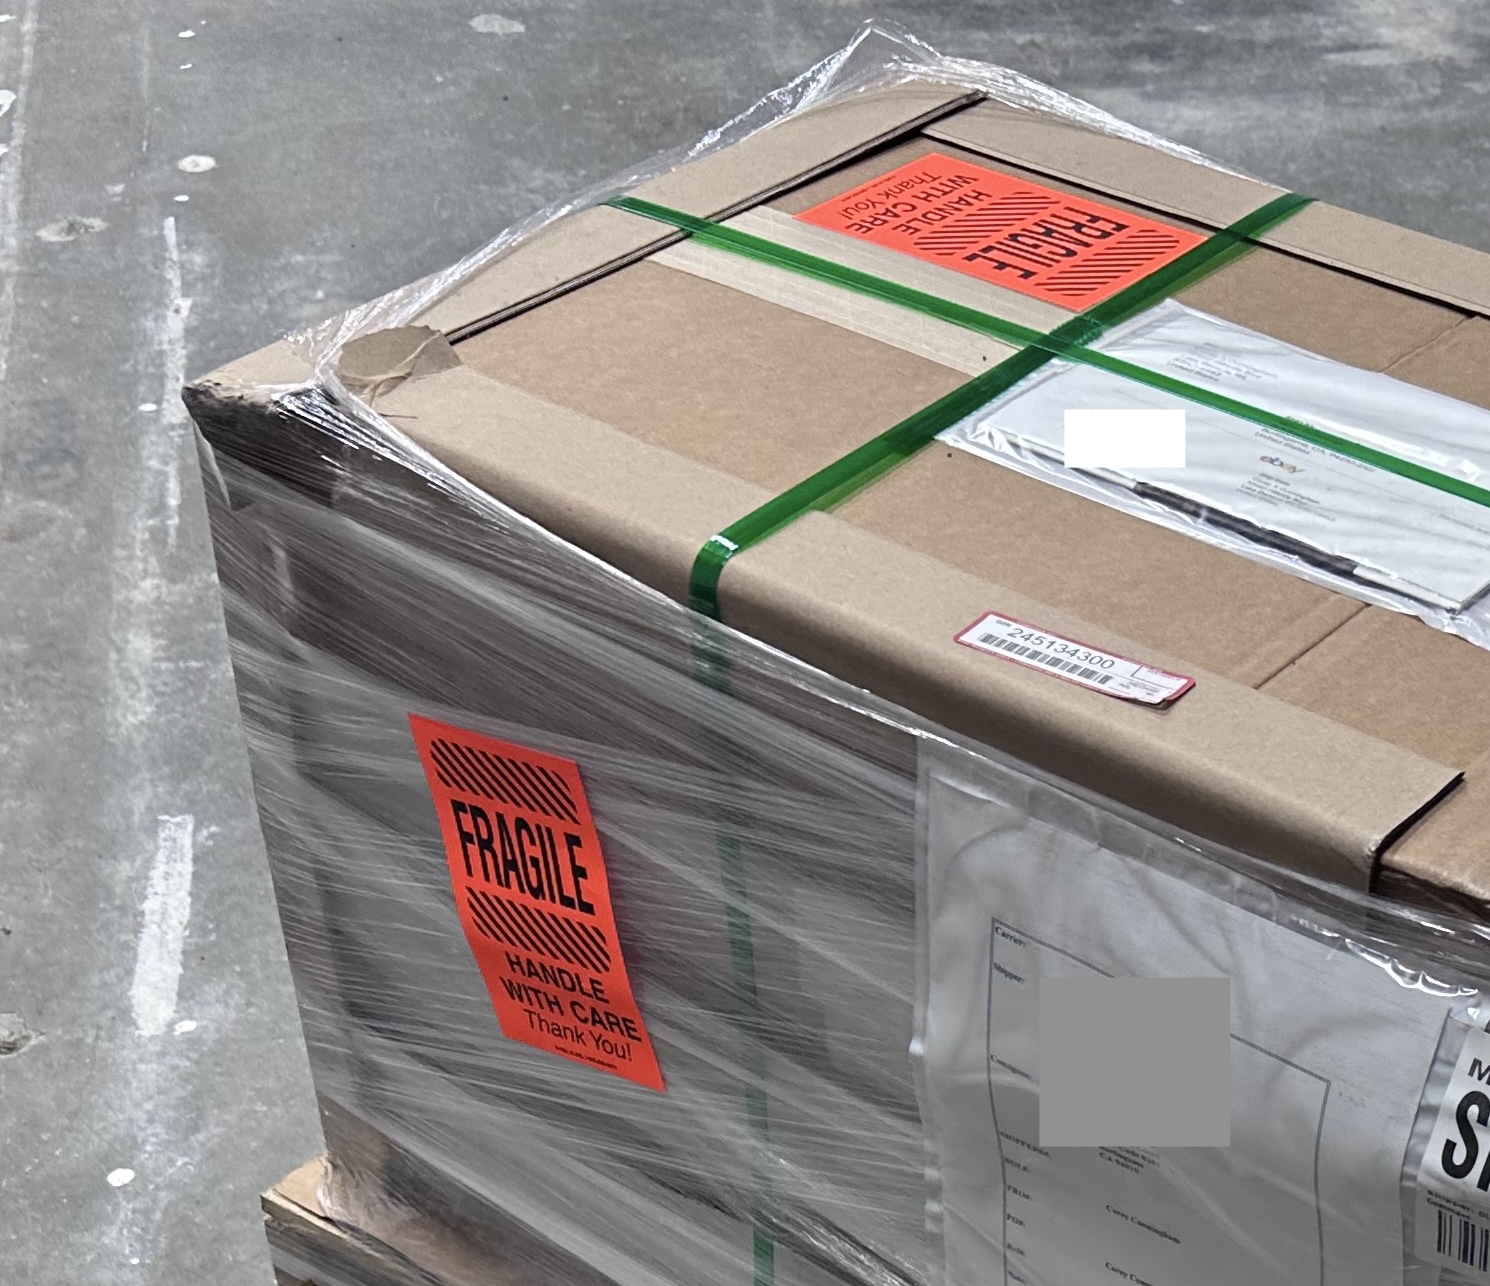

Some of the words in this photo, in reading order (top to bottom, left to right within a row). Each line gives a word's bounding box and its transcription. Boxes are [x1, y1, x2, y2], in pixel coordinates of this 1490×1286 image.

[876, 171, 942, 200] Thank
[911, 174, 979, 203] WITH
[838, 198, 888, 221] You!
[845, 202, 918, 235] CARE
[896, 189, 992, 235] HANDLE
[961, 205, 1131, 281] FRAGILE
[1260, 455, 1306, 474] ebay
[1007, 627, 1115, 670] 245134300
[450, 800, 595, 916] FRAGILE
[505, 951, 609, 1004] HANDLE
[499, 976, 564, 1016] WITH
[570, 1001, 642, 1043] CARE
[523, 1008, 587, 1047] Thank
[588, 1030, 633, 1062] You!
